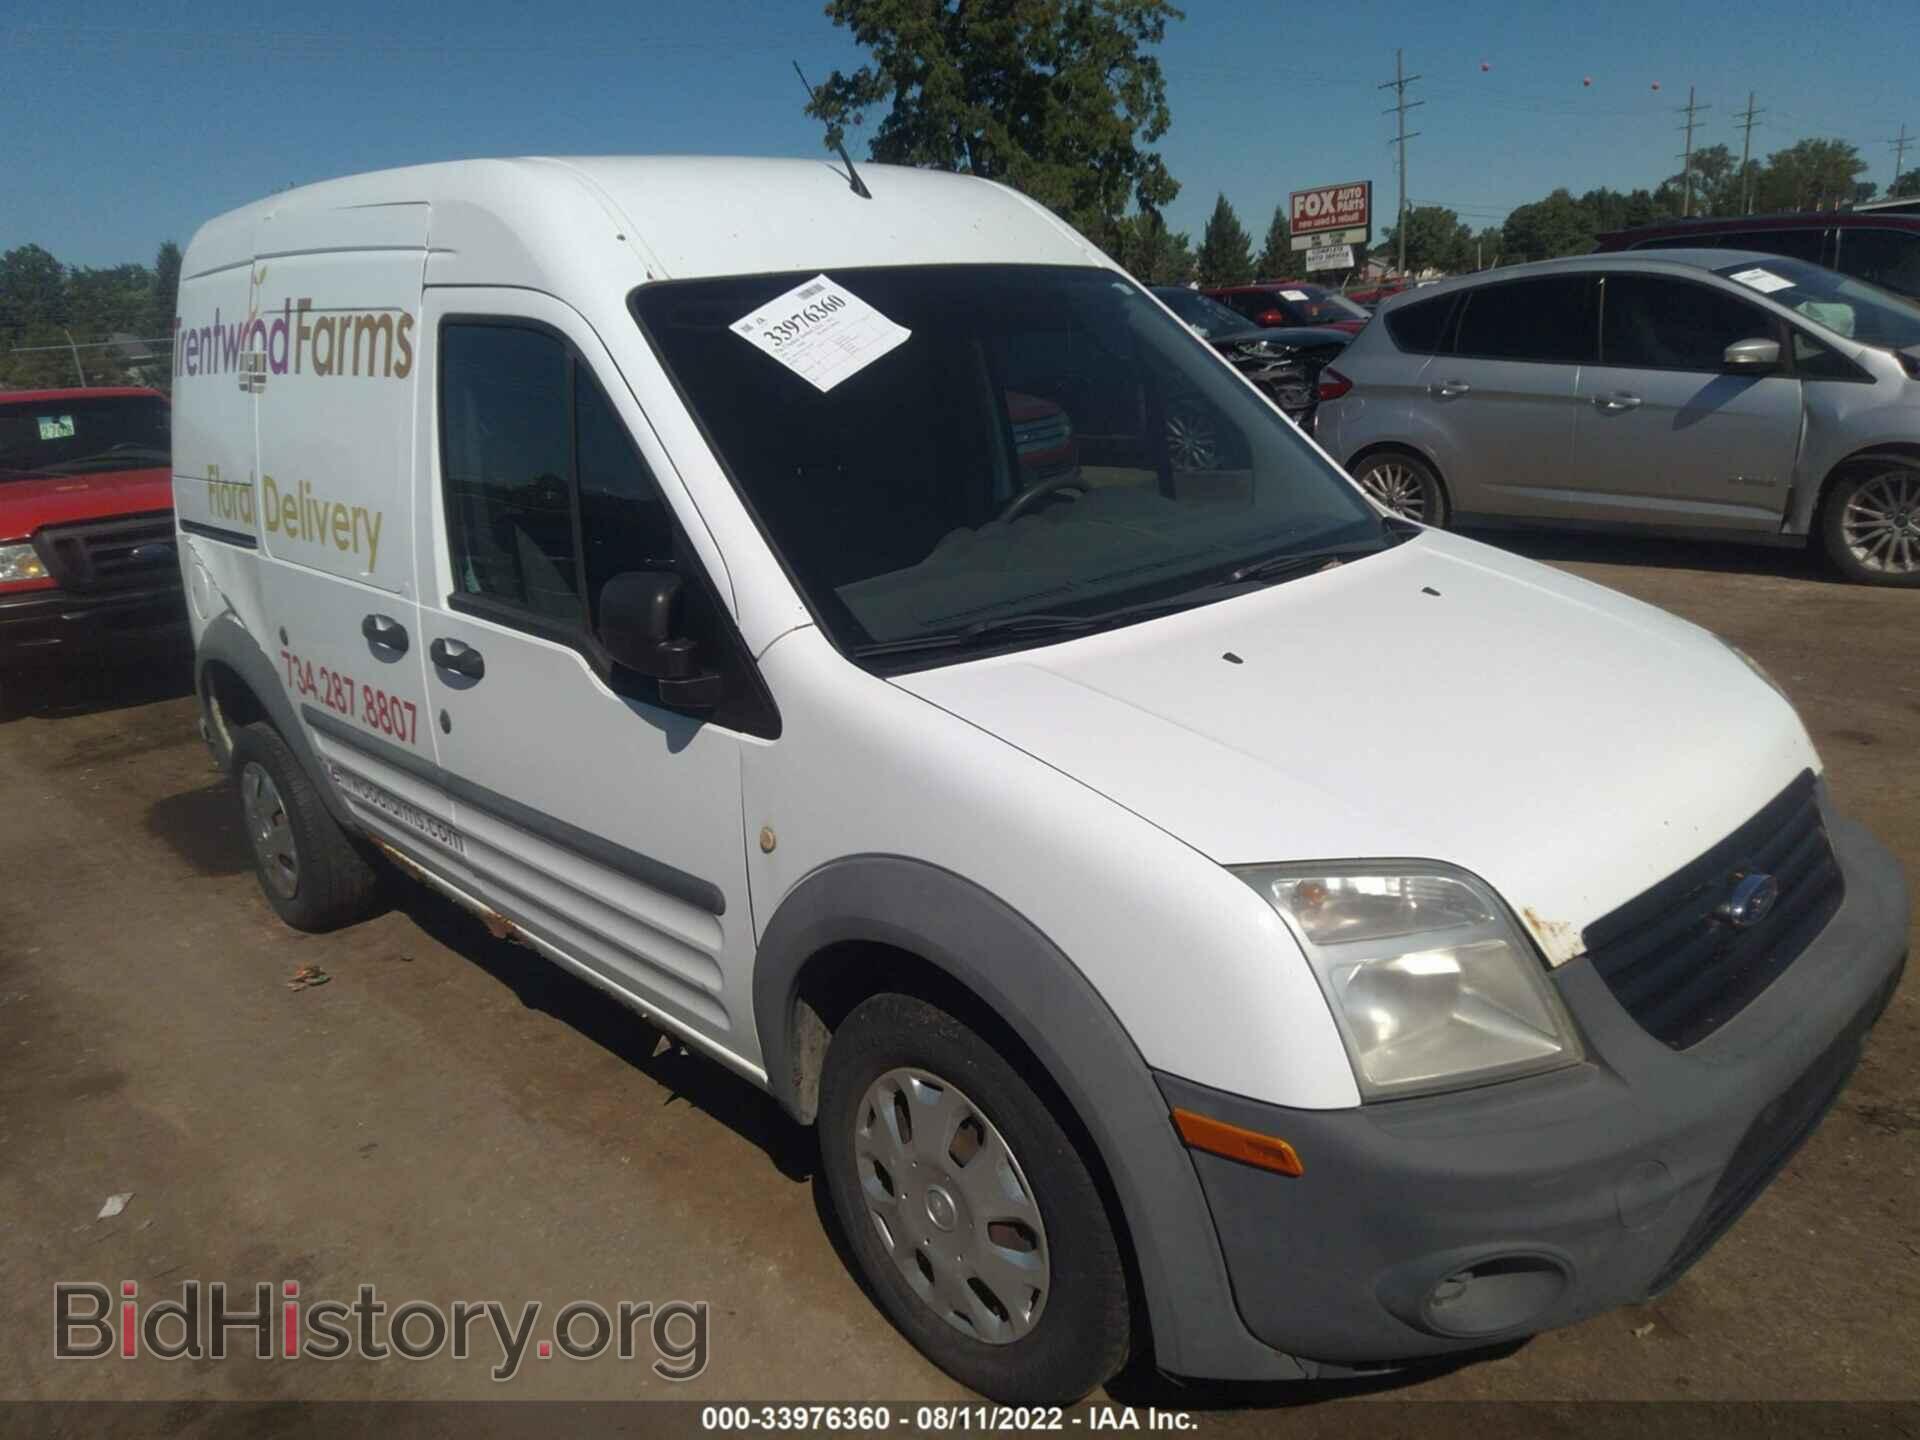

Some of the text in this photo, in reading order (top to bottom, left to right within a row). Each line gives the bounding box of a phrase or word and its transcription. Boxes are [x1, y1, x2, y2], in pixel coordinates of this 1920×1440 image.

[1294, 191, 1336, 219] FOX
[1337, 187, 1362, 201] AUTO
[1337, 198, 1364, 212] PARTS
[295, 298, 415, 379] Farms
[763, 294, 847, 347] 33976360
[207, 464, 382, 573] Floral Delivery
